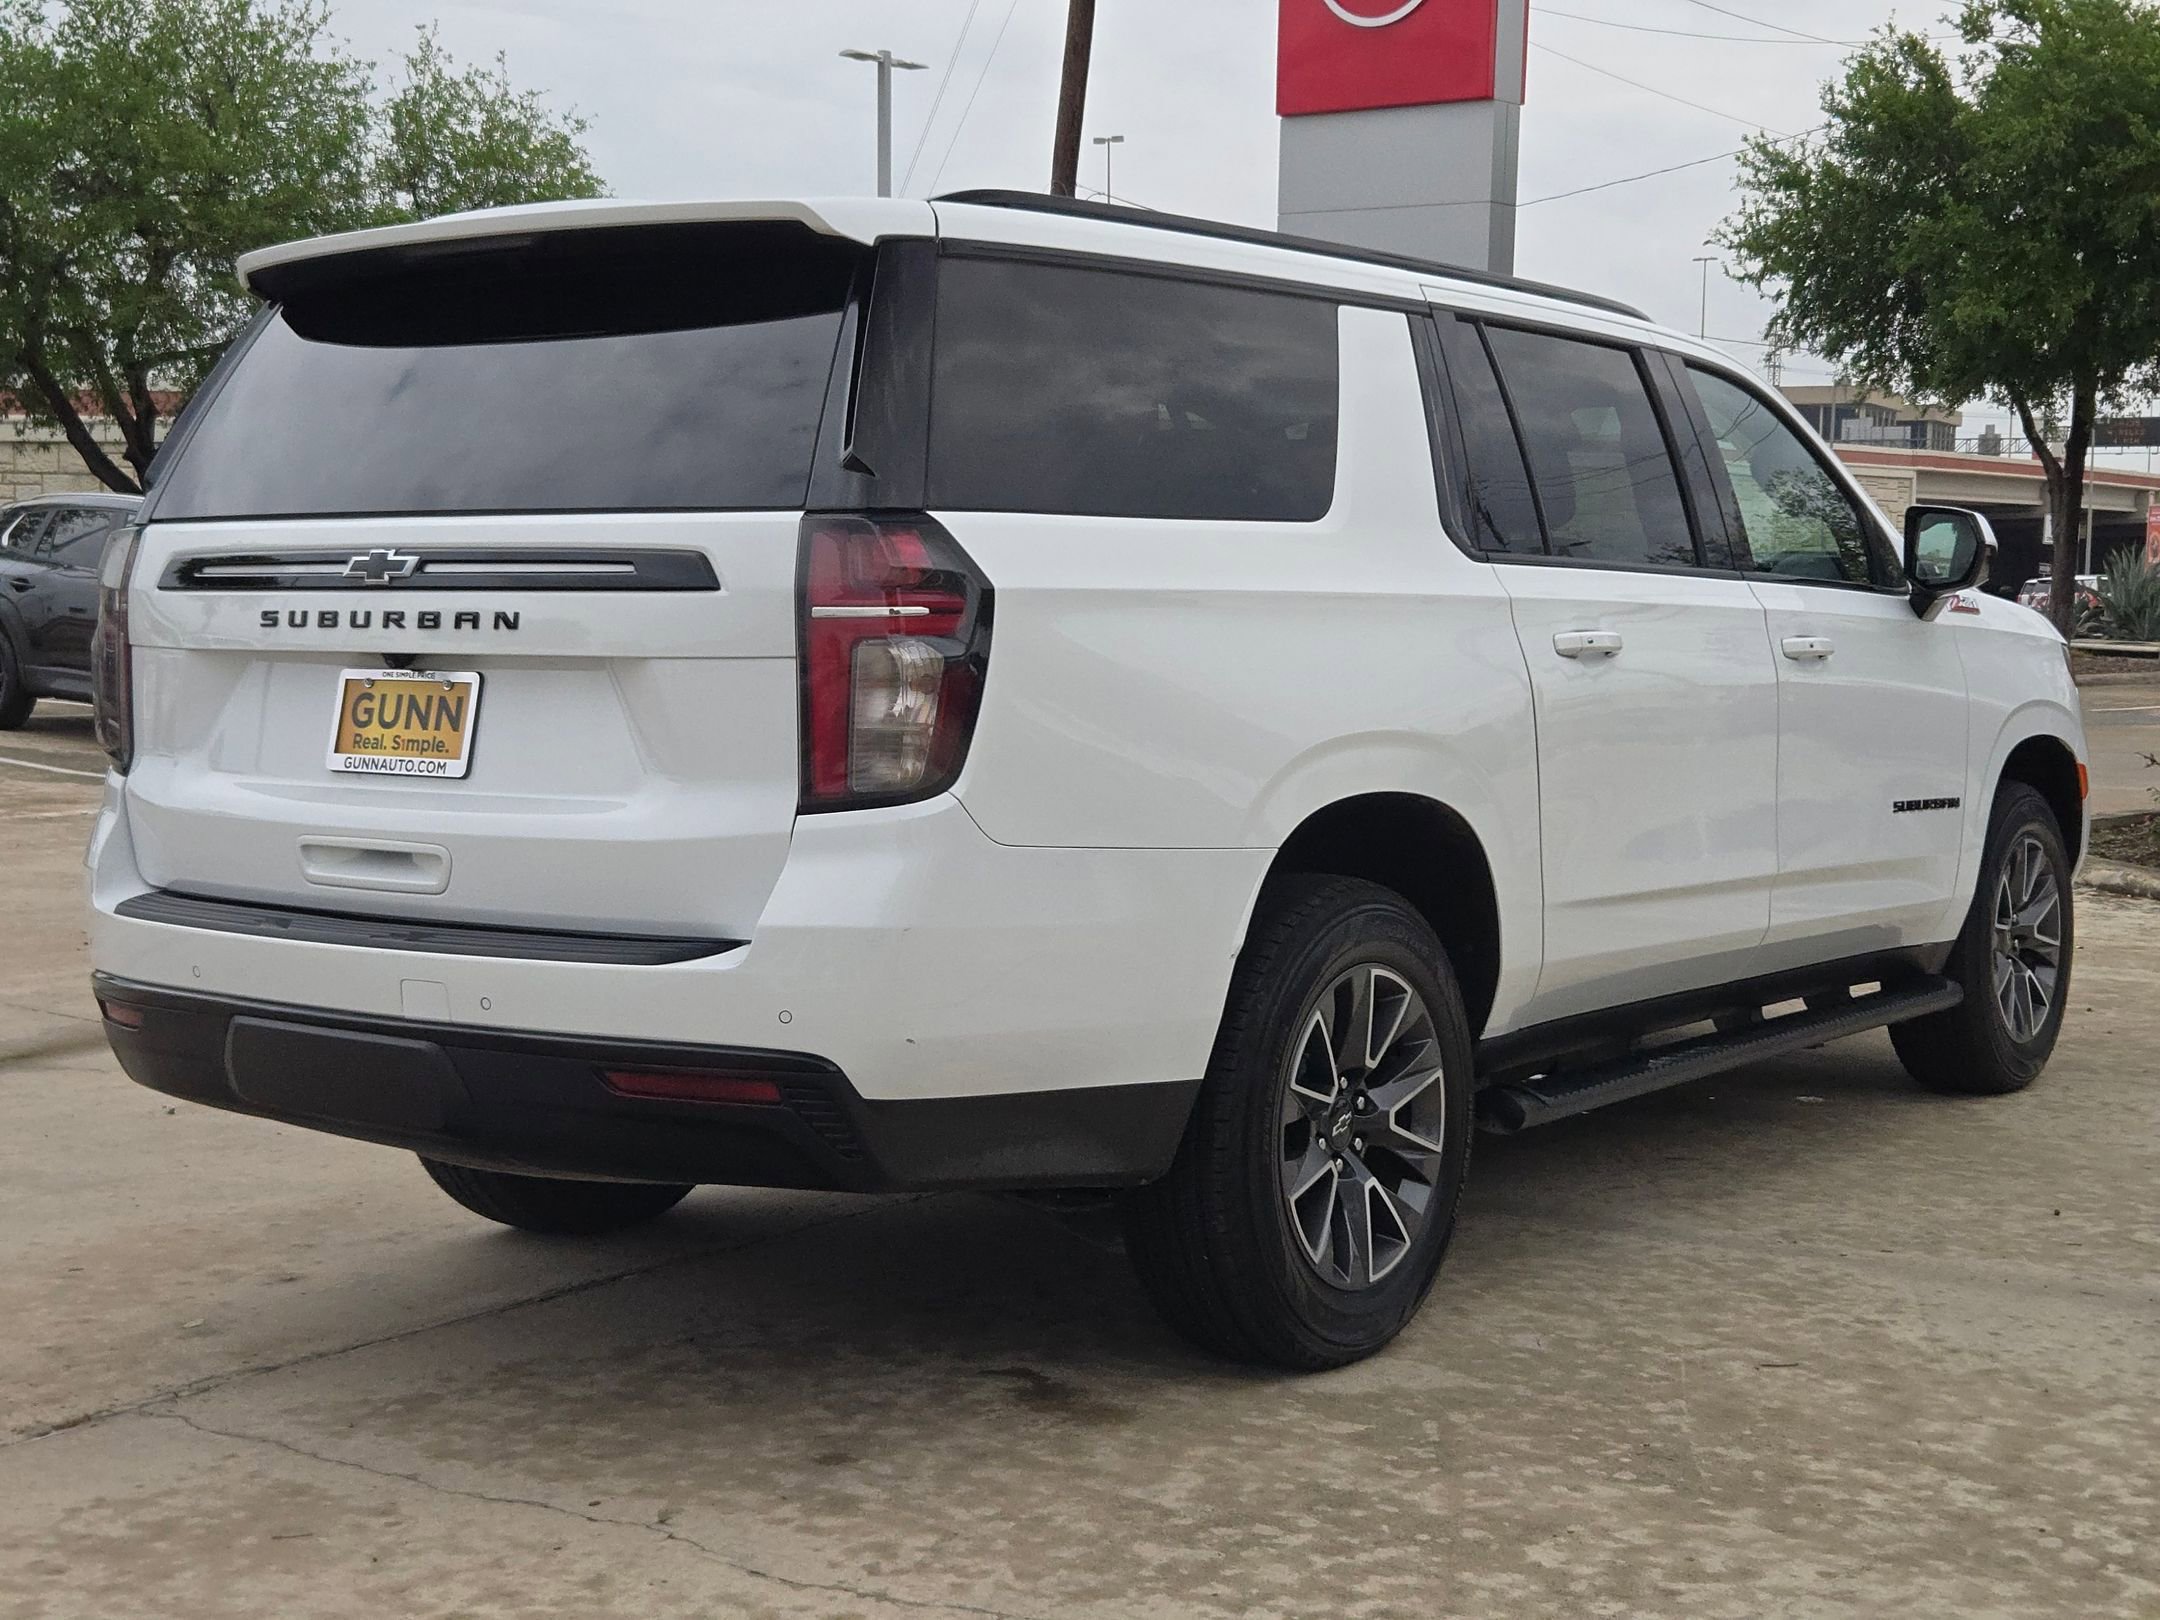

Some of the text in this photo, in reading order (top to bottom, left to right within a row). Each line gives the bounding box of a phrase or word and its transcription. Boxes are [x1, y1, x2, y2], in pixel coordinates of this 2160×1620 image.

[260, 610, 520, 630] SUBURBAN
[395, 671, 416, 679] SIMPLE
[417, 672, 435, 680] PRICE
[351, 692, 464, 732] GUNN
[352, 733, 387, 750] Real.
[344, 756, 447, 775] GUNNAUTO.COM
